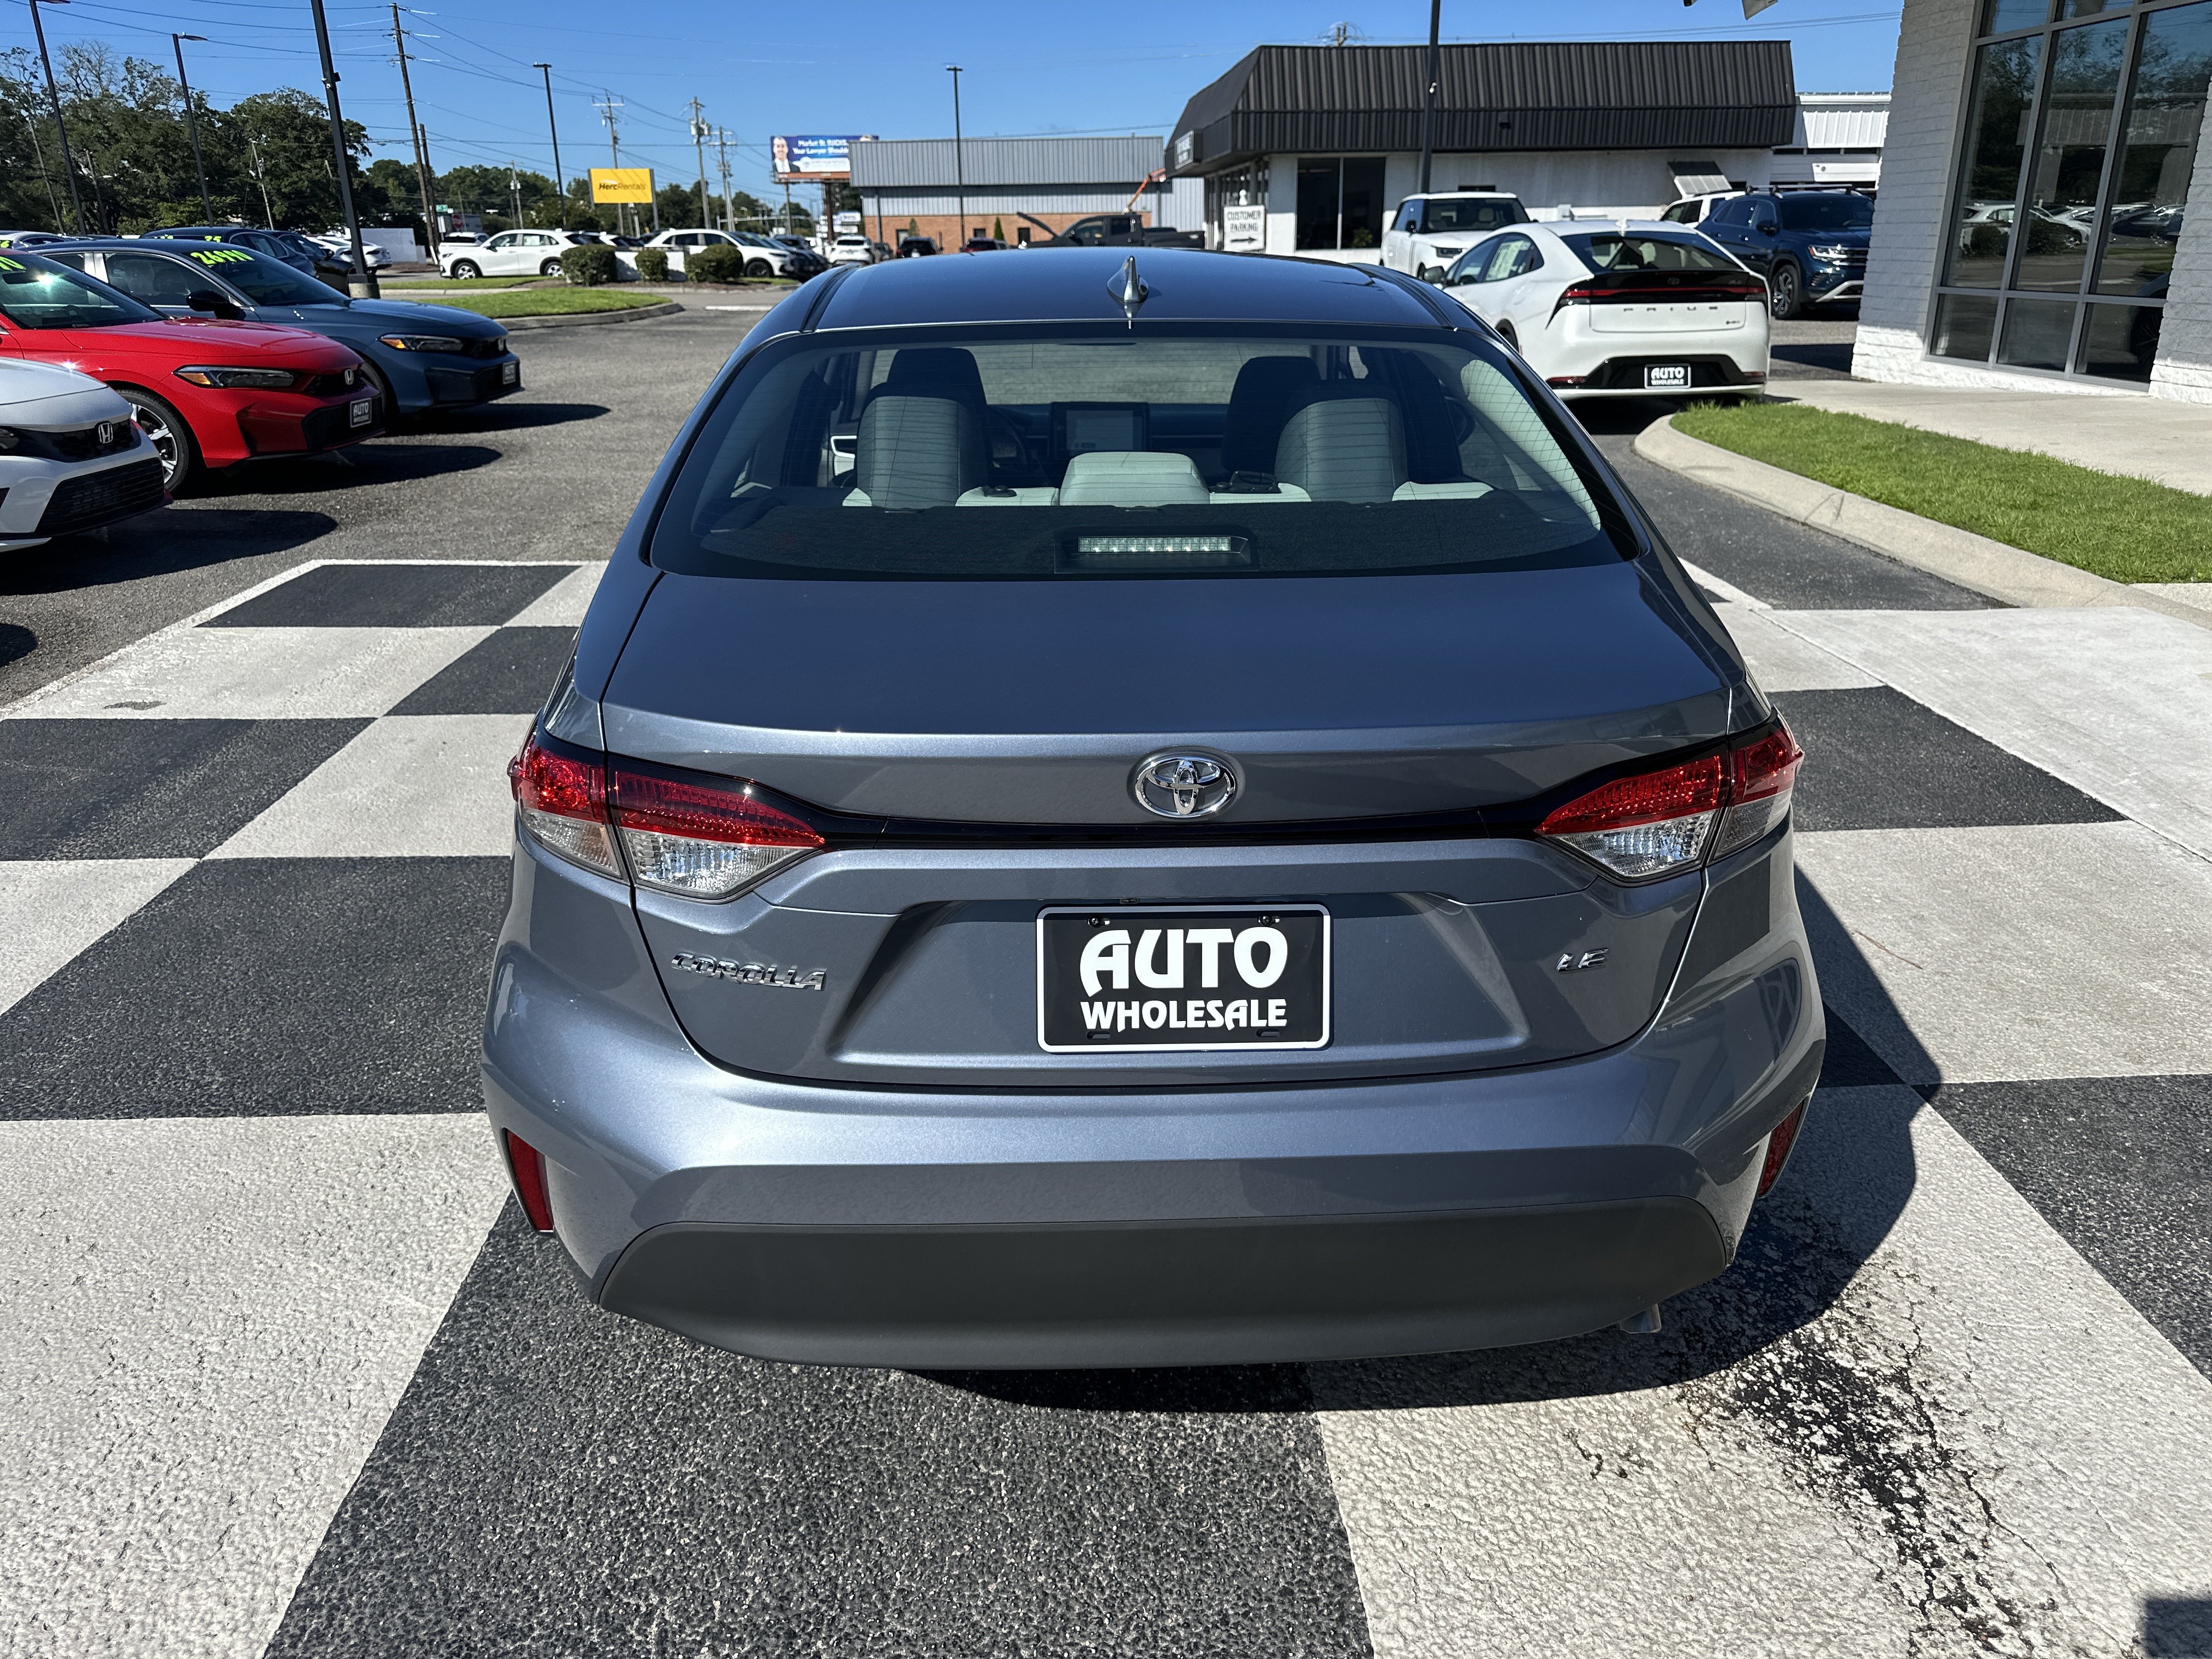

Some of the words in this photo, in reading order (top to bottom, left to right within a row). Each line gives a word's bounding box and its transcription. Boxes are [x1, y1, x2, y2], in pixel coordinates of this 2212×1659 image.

[1227, 210, 1261, 220] CUSTOMER
[1230, 222, 1259, 233] PARKING
[190, 250, 255, 267] 26990
[1651, 366, 1684, 380] AUTO
[353, 402, 369, 417] AUTO
[1080, 927, 1288, 997] AUTO
[1556, 947, 1609, 972] LE
[671, 952, 827, 991] COROLLA
[1080, 998, 1287, 1032] WHOLESALE
